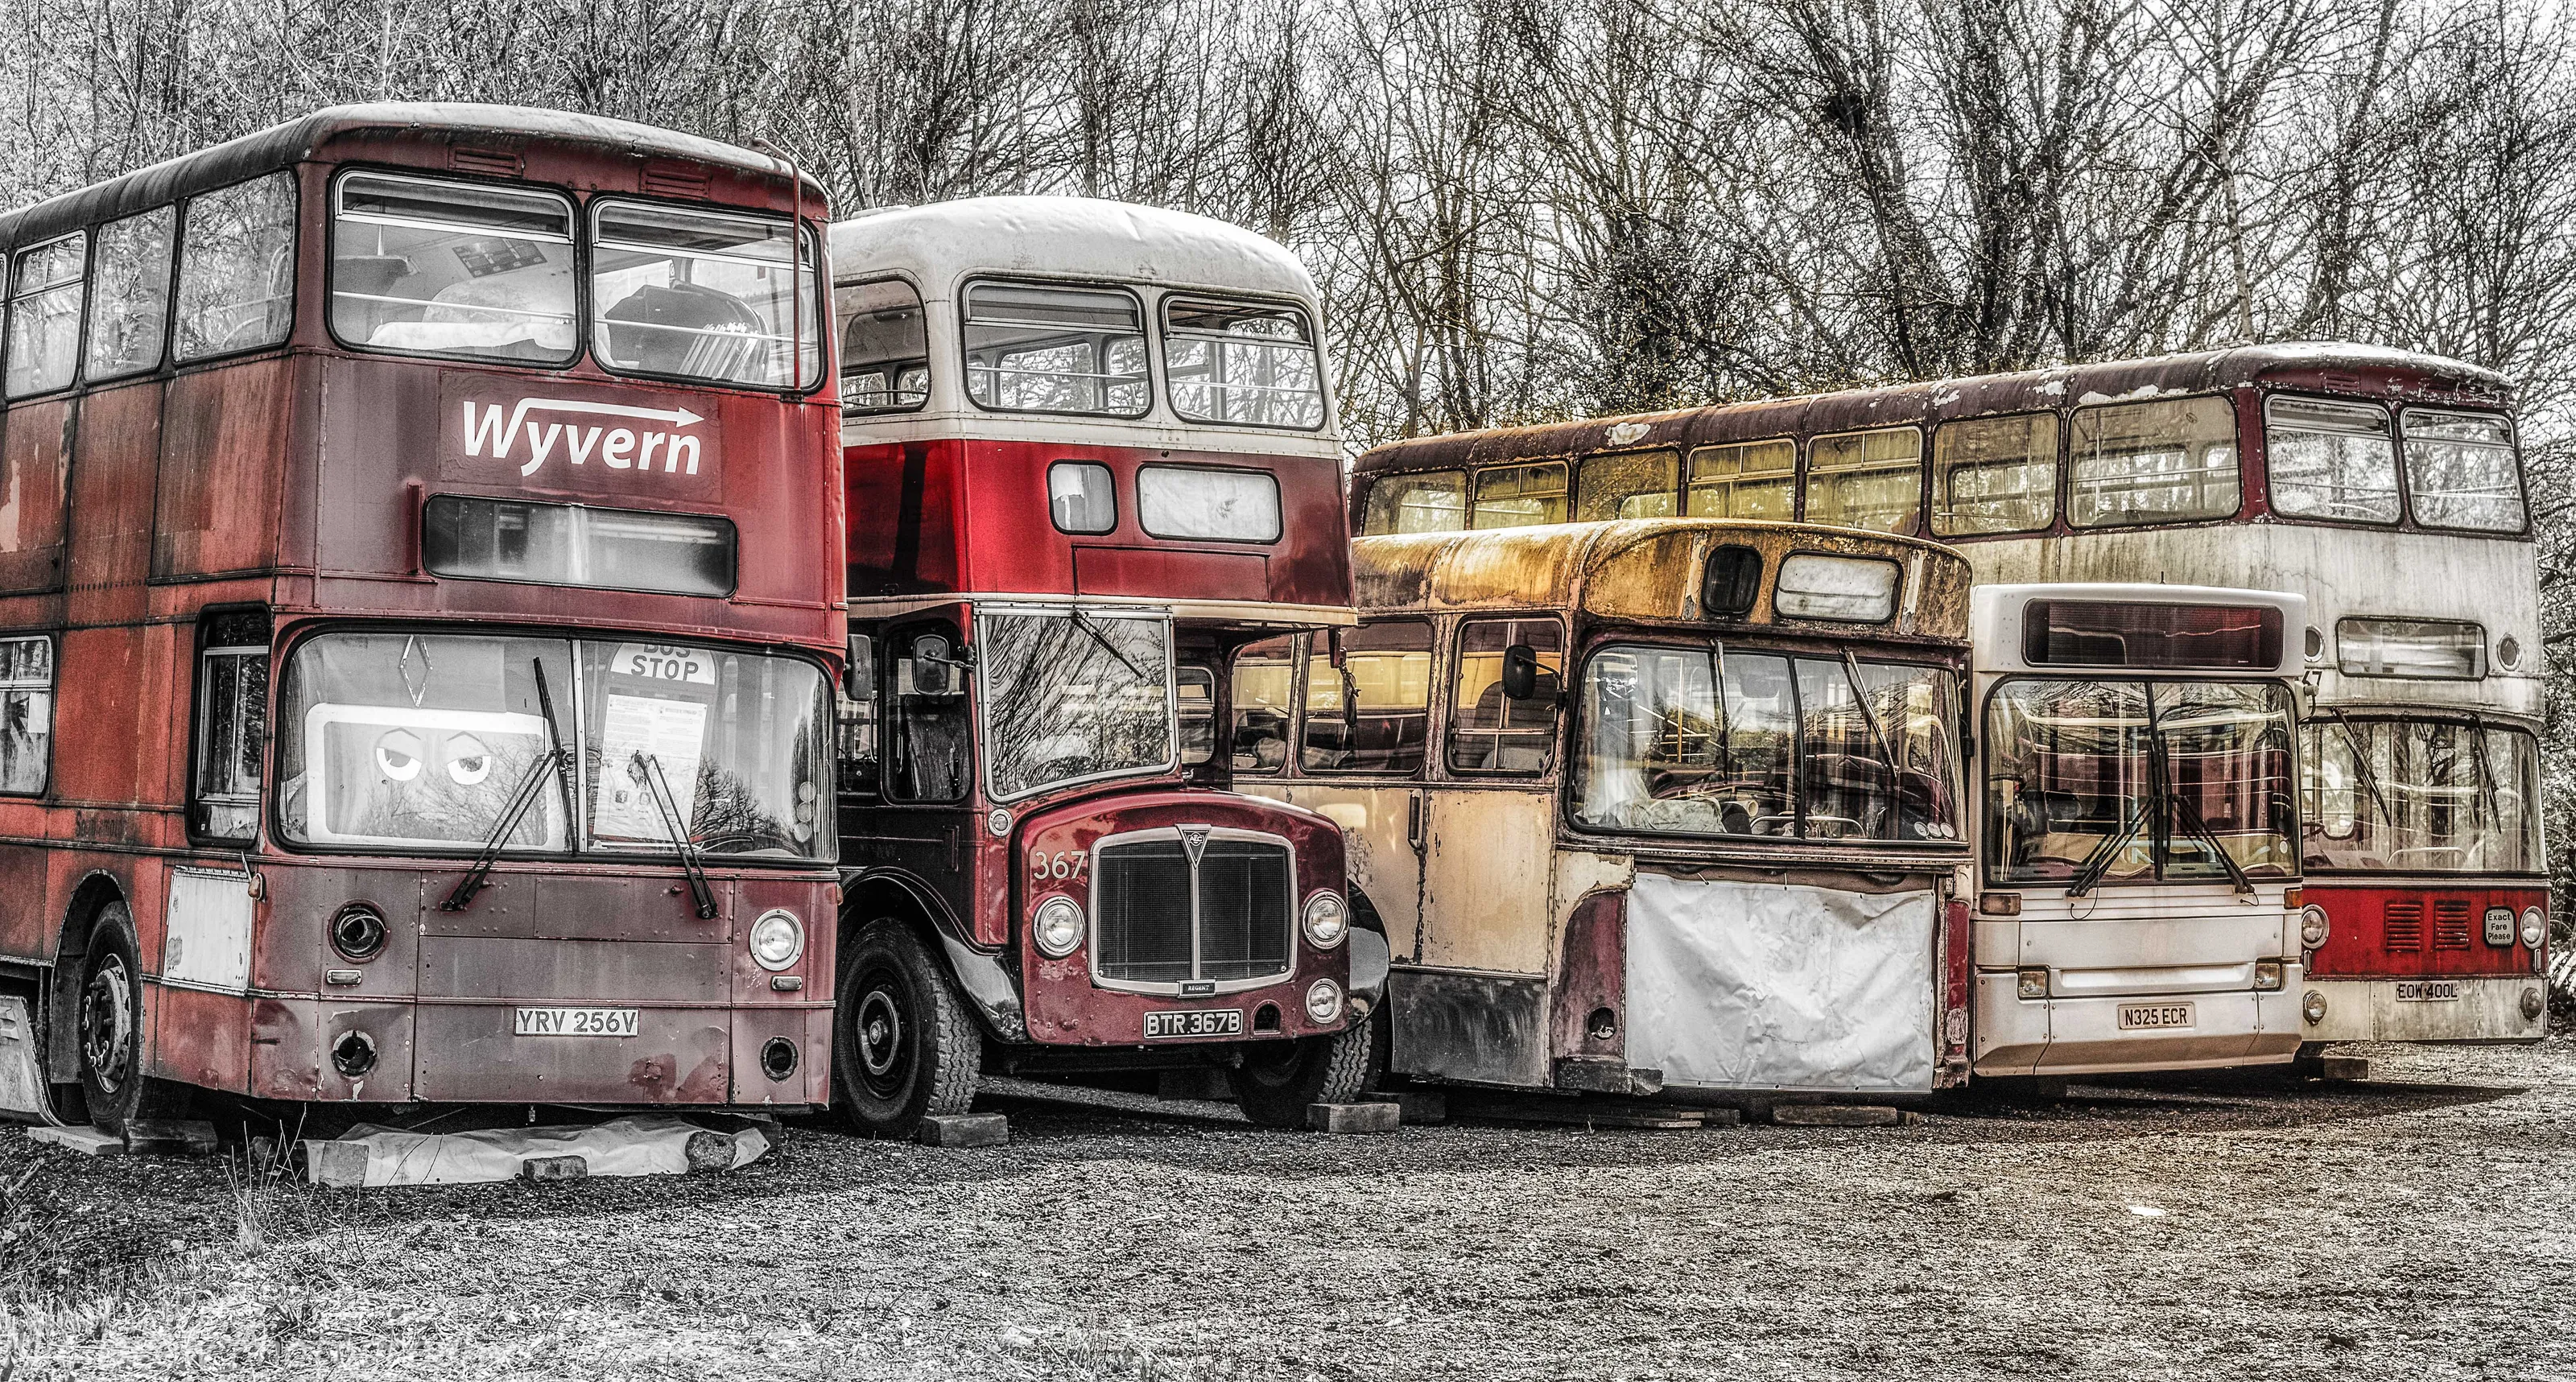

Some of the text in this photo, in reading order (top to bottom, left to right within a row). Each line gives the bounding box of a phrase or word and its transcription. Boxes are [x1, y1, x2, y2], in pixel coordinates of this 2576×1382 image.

[464, 398, 701, 476] Wyvern
[631, 654, 699, 681] STOP
[1034, 851, 1085, 880] 367
[2487, 913, 2511, 921] Exact
[2487, 932, 2511, 940] Please
[2398, 984, 2458, 998] EOW 400L
[519, 1010, 636, 1033] YRV 256V
[1147, 1013, 1241, 1035] BTR 367B
[2125, 1008, 2187, 1025] N325 ECR
